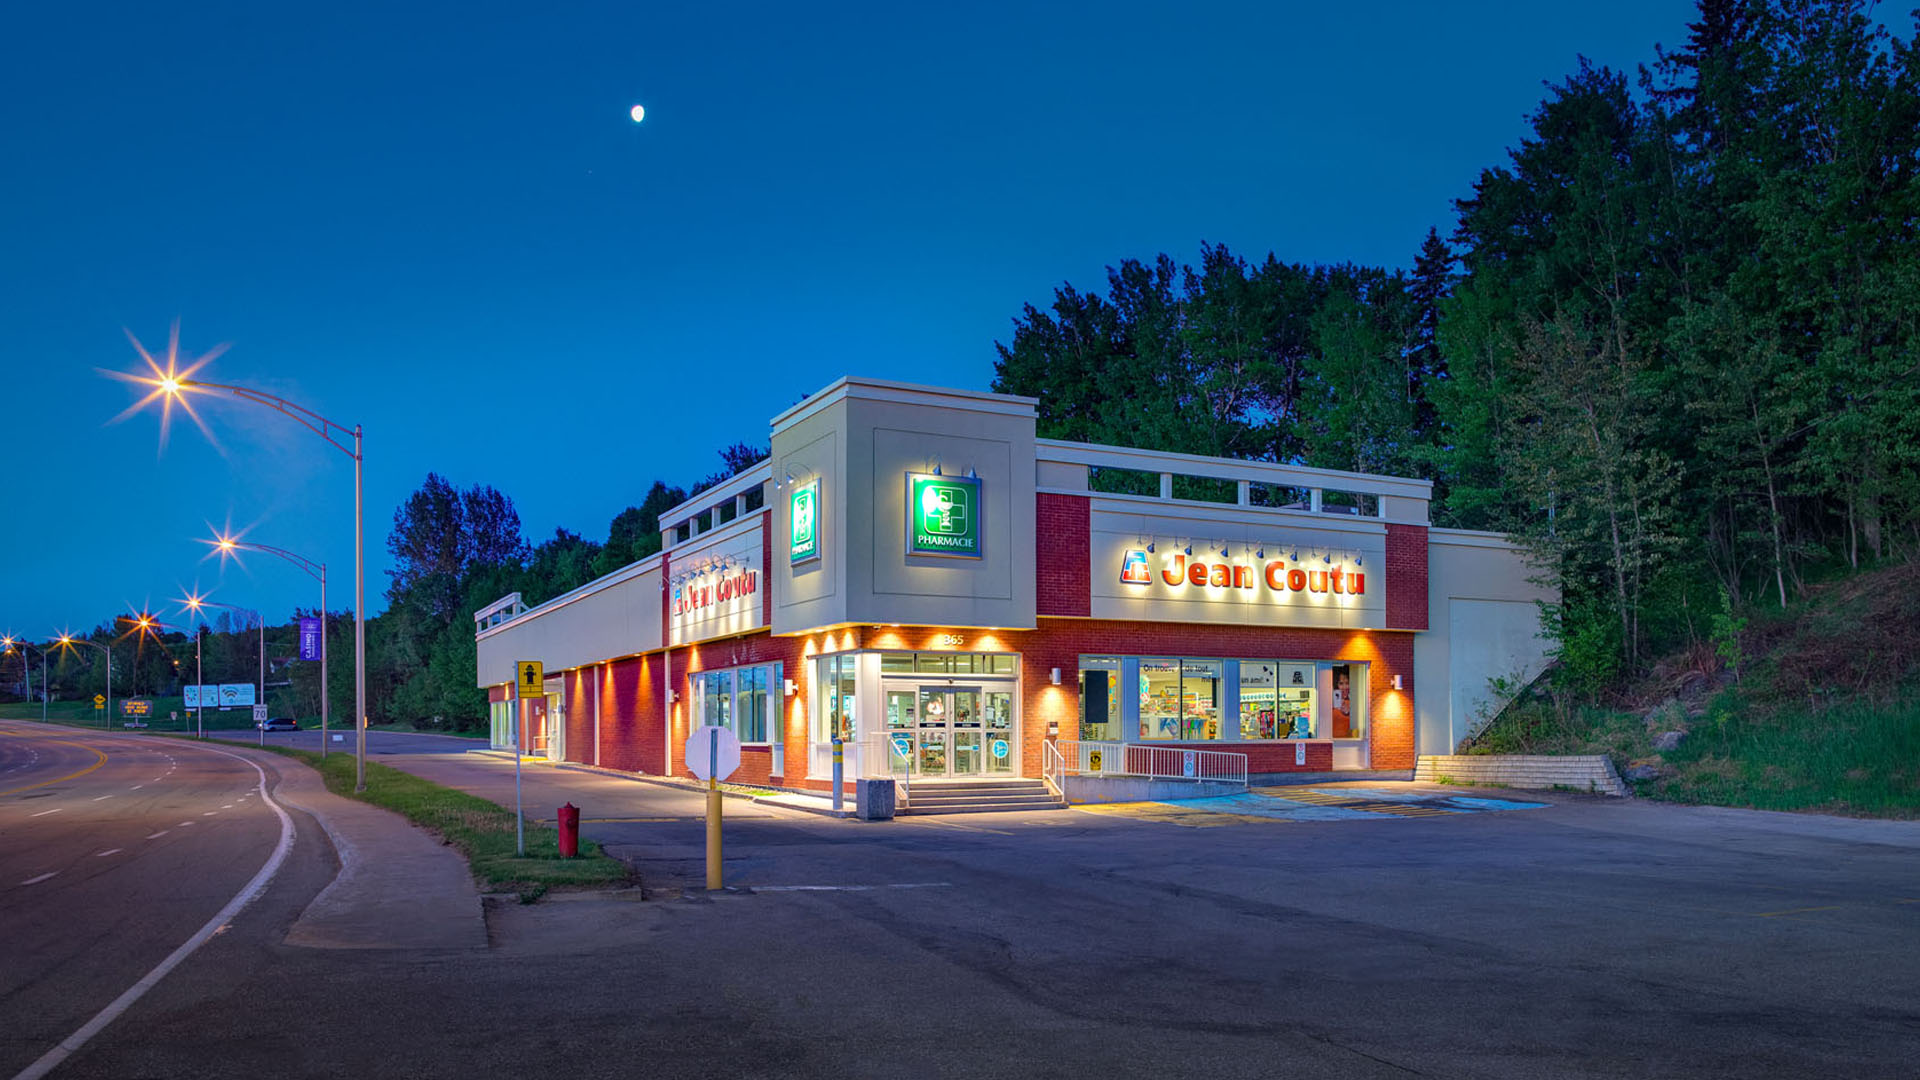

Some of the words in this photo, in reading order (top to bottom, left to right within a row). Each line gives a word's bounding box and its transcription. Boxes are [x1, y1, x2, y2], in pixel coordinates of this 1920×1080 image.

[918, 535, 973, 547] PHARMACIE
[1162, 555, 1254, 589] Jean
[1265, 561, 1365, 595] Coutu
[684, 584, 714, 613] Jean
[716, 567, 757, 603] Coutu
[943, 634, 964, 645] 365
[1143, 664, 1153, 672] On
[255, 710, 266, 718] 70
